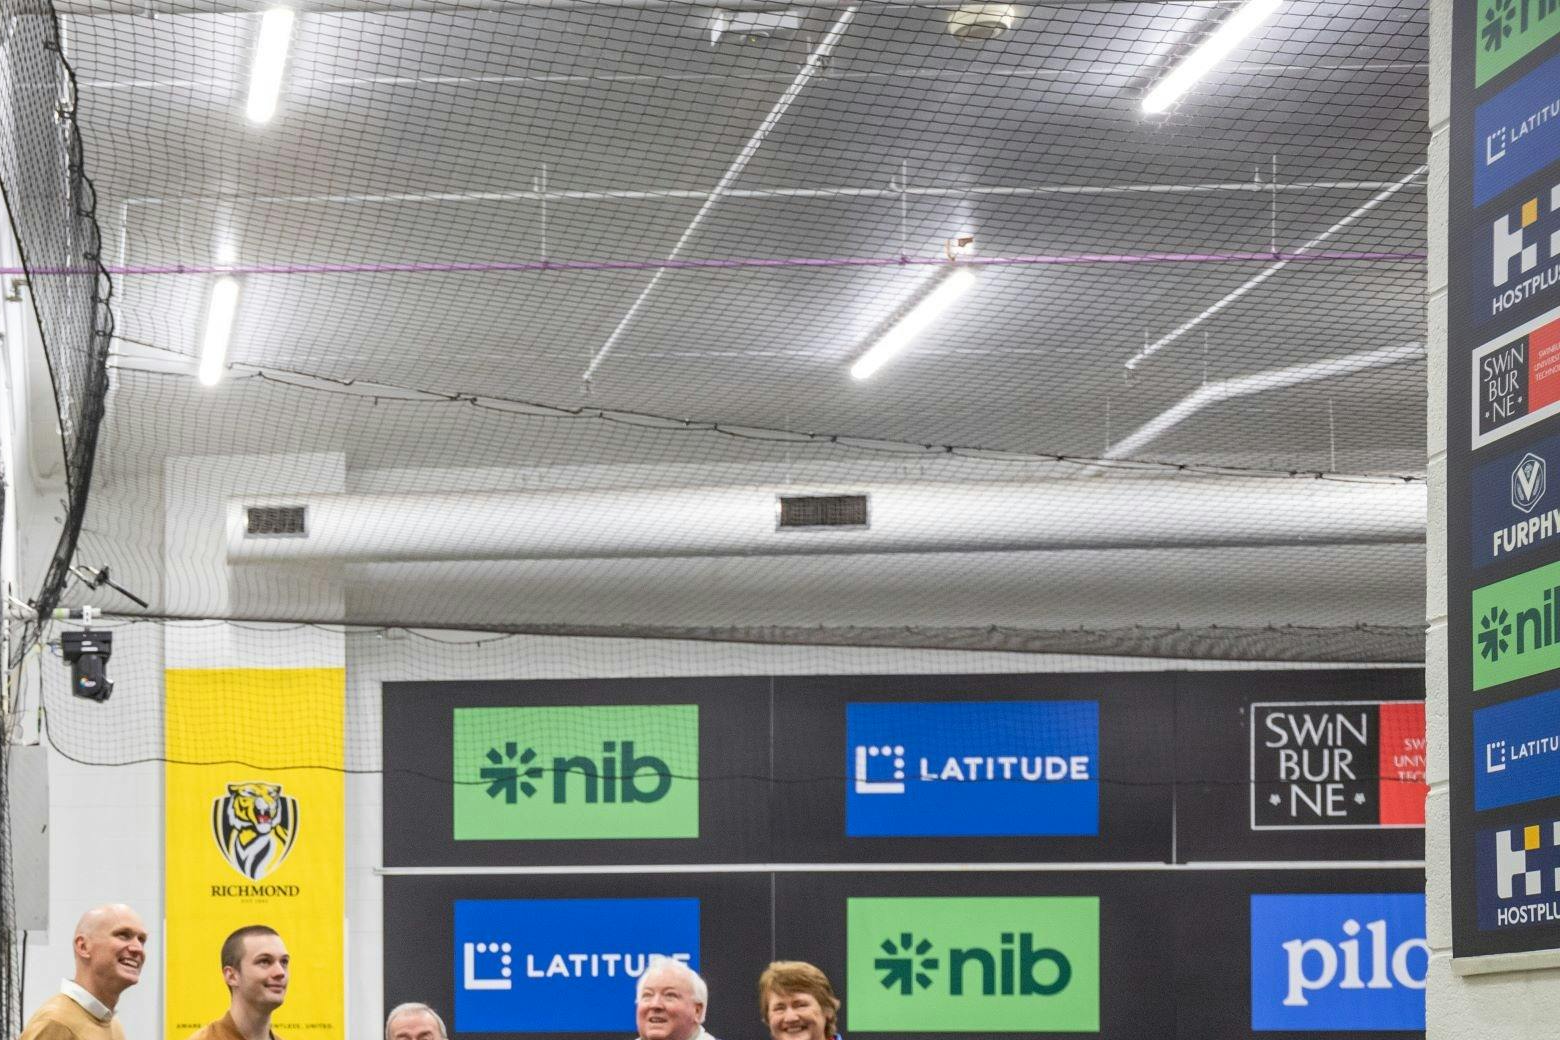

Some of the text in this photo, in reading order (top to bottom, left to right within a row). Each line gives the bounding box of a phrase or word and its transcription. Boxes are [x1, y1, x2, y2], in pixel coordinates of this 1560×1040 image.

[1492, 264, 1560, 315] HOSTPLU
[1489, 370, 1520, 402] BUR
[1493, 394, 1515, 422] NE
[1517, 585, 1560, 655] ni
[552, 741, 673, 805] nib
[920, 756, 1090, 781] LATITUDE
[1280, 749, 1356, 781] BUR
[1292, 784, 1347, 817] NE
[211, 885, 300, 897] RICHMOND
[949, 933, 1072, 996] nib
